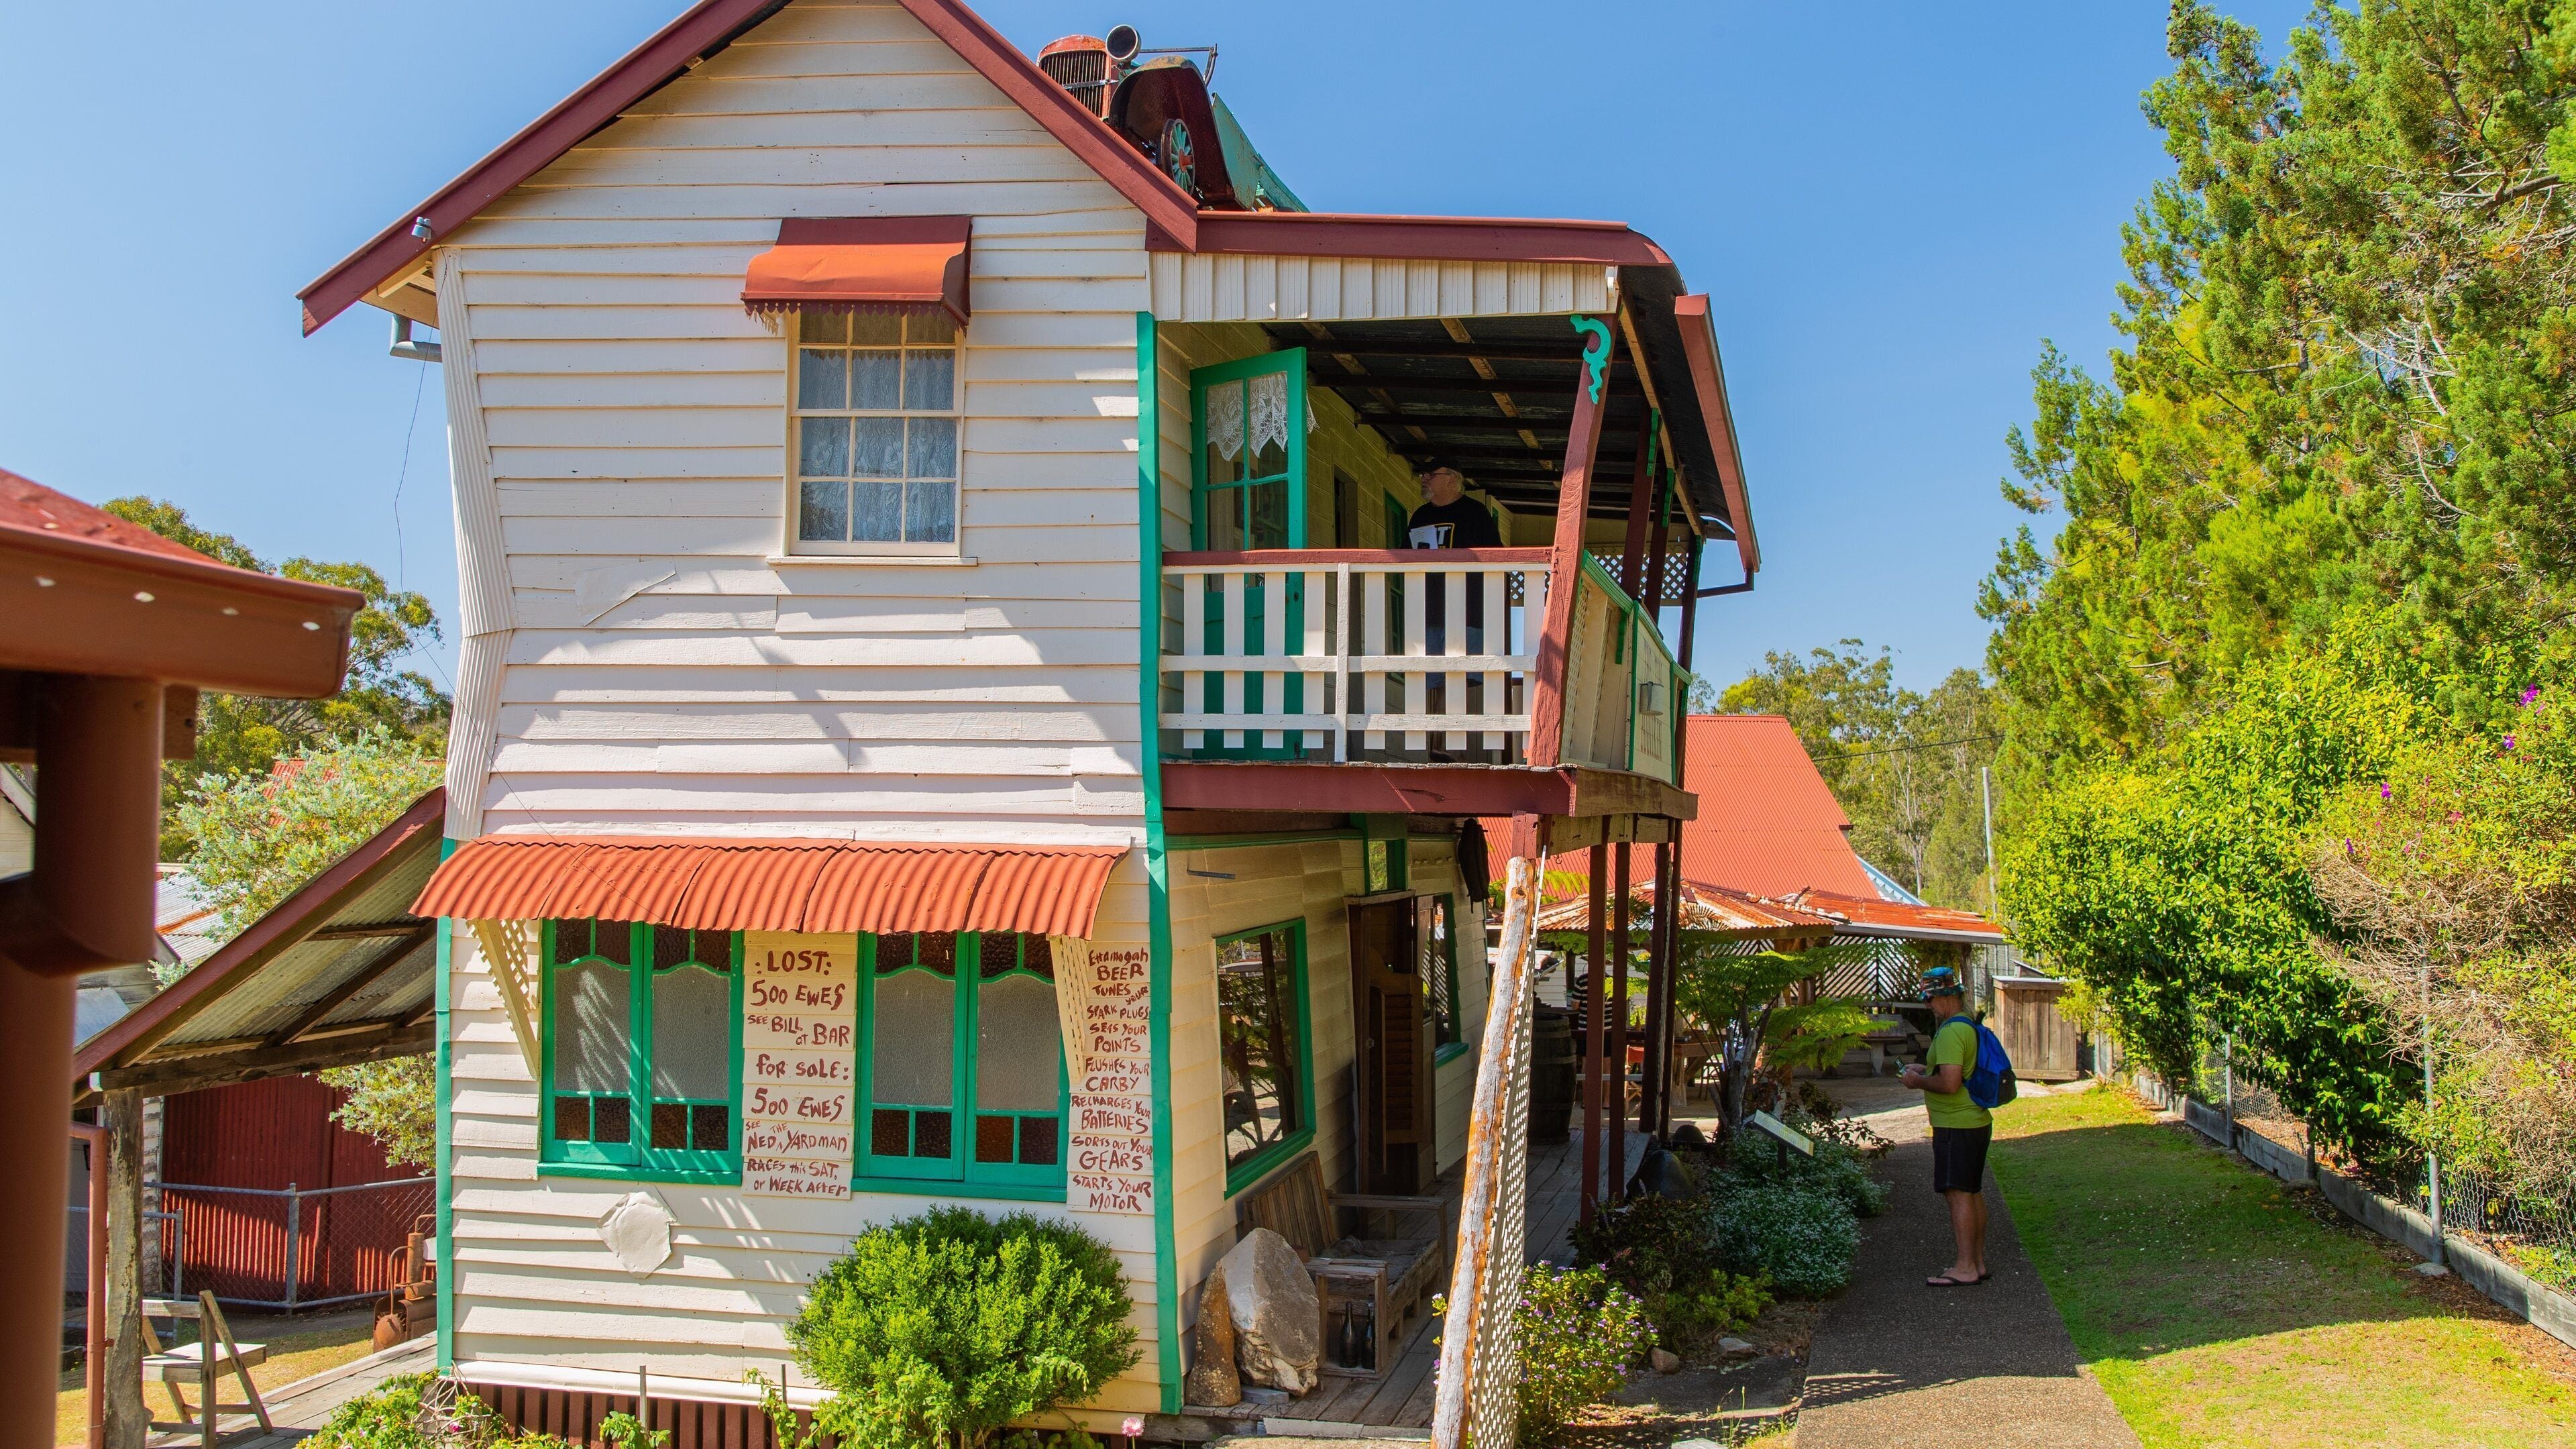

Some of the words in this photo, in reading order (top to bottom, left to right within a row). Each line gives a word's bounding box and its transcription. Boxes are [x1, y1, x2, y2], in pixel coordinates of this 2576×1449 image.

[1097, 963, 1144, 981] BEER
[750, 979, 788, 1006] 500
[795, 983, 845, 1011] EWES
[1091, 983, 1131, 996] TUNES
[1087, 1004, 1117, 1019] SPARK
[1120, 1006, 1149, 1020] PLUGS
[747, 1015, 768, 1025] SEE
[771, 1016, 803, 1034] BILL
[1089, 1022, 1119, 1034] SETS
[1122, 1023, 1146, 1036] YOUR
[811, 1023, 850, 1047] BAR
[1093, 1035, 1141, 1053] POINTS
[1085, 1057, 1126, 1073] FLUSHES
[1130, 1061, 1150, 1076] YOUR
[1085, 1076, 1139, 1092] CARBY
[751, 1087, 789, 1116] 500
[797, 1095, 845, 1122] EWES
[1071, 1095, 1132, 1110] RECHARGES
[1134, 1101, 1150, 1120] YOUR
[745, 1120, 761, 1131] SEE
[769, 1122, 789, 1134] THE
[1081, 1108, 1148, 1134] BATTERIES
[1071, 1136, 1110, 1147] SORTS
[1112, 1140, 1128, 1150] OUT
[1130, 1138, 1153, 1161] YOUR
[747, 1158, 786, 1172] RACES
[790, 1162, 806, 1175] this
[808, 1161, 839, 1181] SAT.
[1079, 1150, 1143, 1173] GEARS
[753, 1179, 766, 1191] or
[769, 1175, 804, 1194] WEEK
[1073, 1175, 1112, 1191] STARTS
[1118, 1177, 1151, 1198] YOUR
[1089, 1192, 1142, 1212] MOTOR
